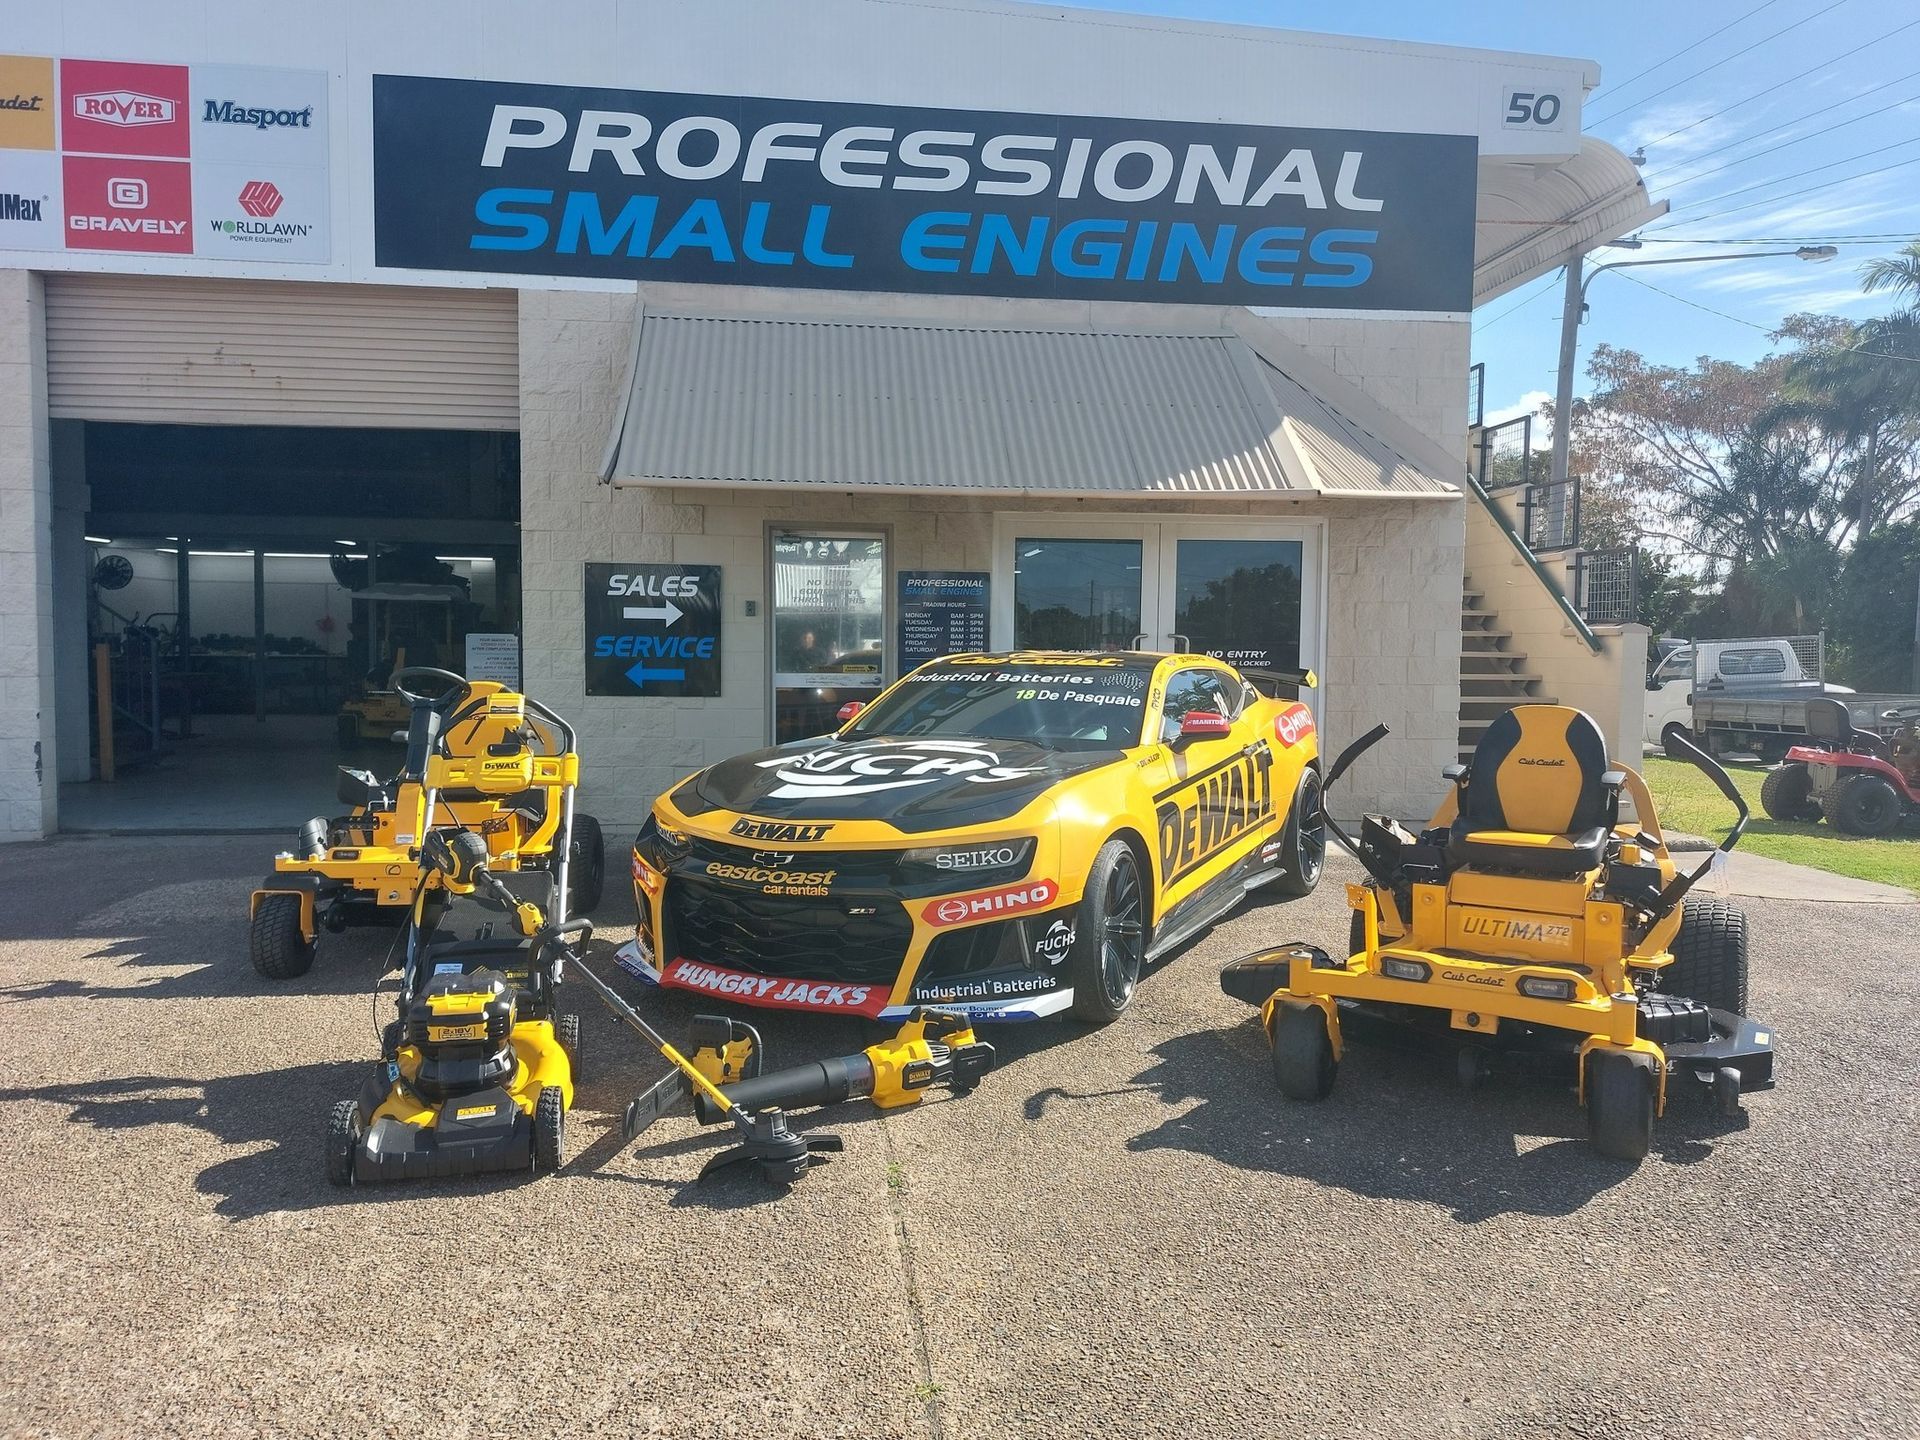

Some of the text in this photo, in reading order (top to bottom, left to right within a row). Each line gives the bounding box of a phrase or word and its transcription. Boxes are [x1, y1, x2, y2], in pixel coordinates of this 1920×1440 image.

[85, 95, 164, 123] ROVER
[203, 99, 311, 129] Masport
[1506, 93, 1560, 125] 50
[480, 103, 1384, 212] PROFESSIONAL
[69, 215, 187, 235] GRAVELY
[210, 220, 307, 236] WORLDLAWN
[255, 236, 292, 244] EQUIPMENT
[469, 187, 1380, 288] SMALL ENGINES
[606, 574, 700, 597] SALES
[906, 579, 984, 588] PROFESSIONAL
[939, 588, 983, 596] ENGINES
[593, 635, 715, 659] SERVICE
[1206, 650, 1267, 658] NO ENTRY
[995, 673, 1094, 684] Batteries
[1015, 689, 1141, 707] 18 De Pasquale
[754, 752, 1048, 783] FUCHS
[1518, 758, 1566, 767] Cub Cadet
[935, 848, 1014, 869] SEIKO
[706, 862, 837, 884] eastcoast
[763, 885, 829, 896] car rentals
[970, 885, 1049, 914] HINO
[1463, 916, 1570, 942] ULTIMA ZT2
[1035, 930, 1076, 953] FUCHS
[674, 962, 778, 997] HUNGRY
[773, 982, 872, 1005] JACK'S
[993, 976, 1056, 994] Batteries
[1441, 971, 1506, 988] Cub Cadet
